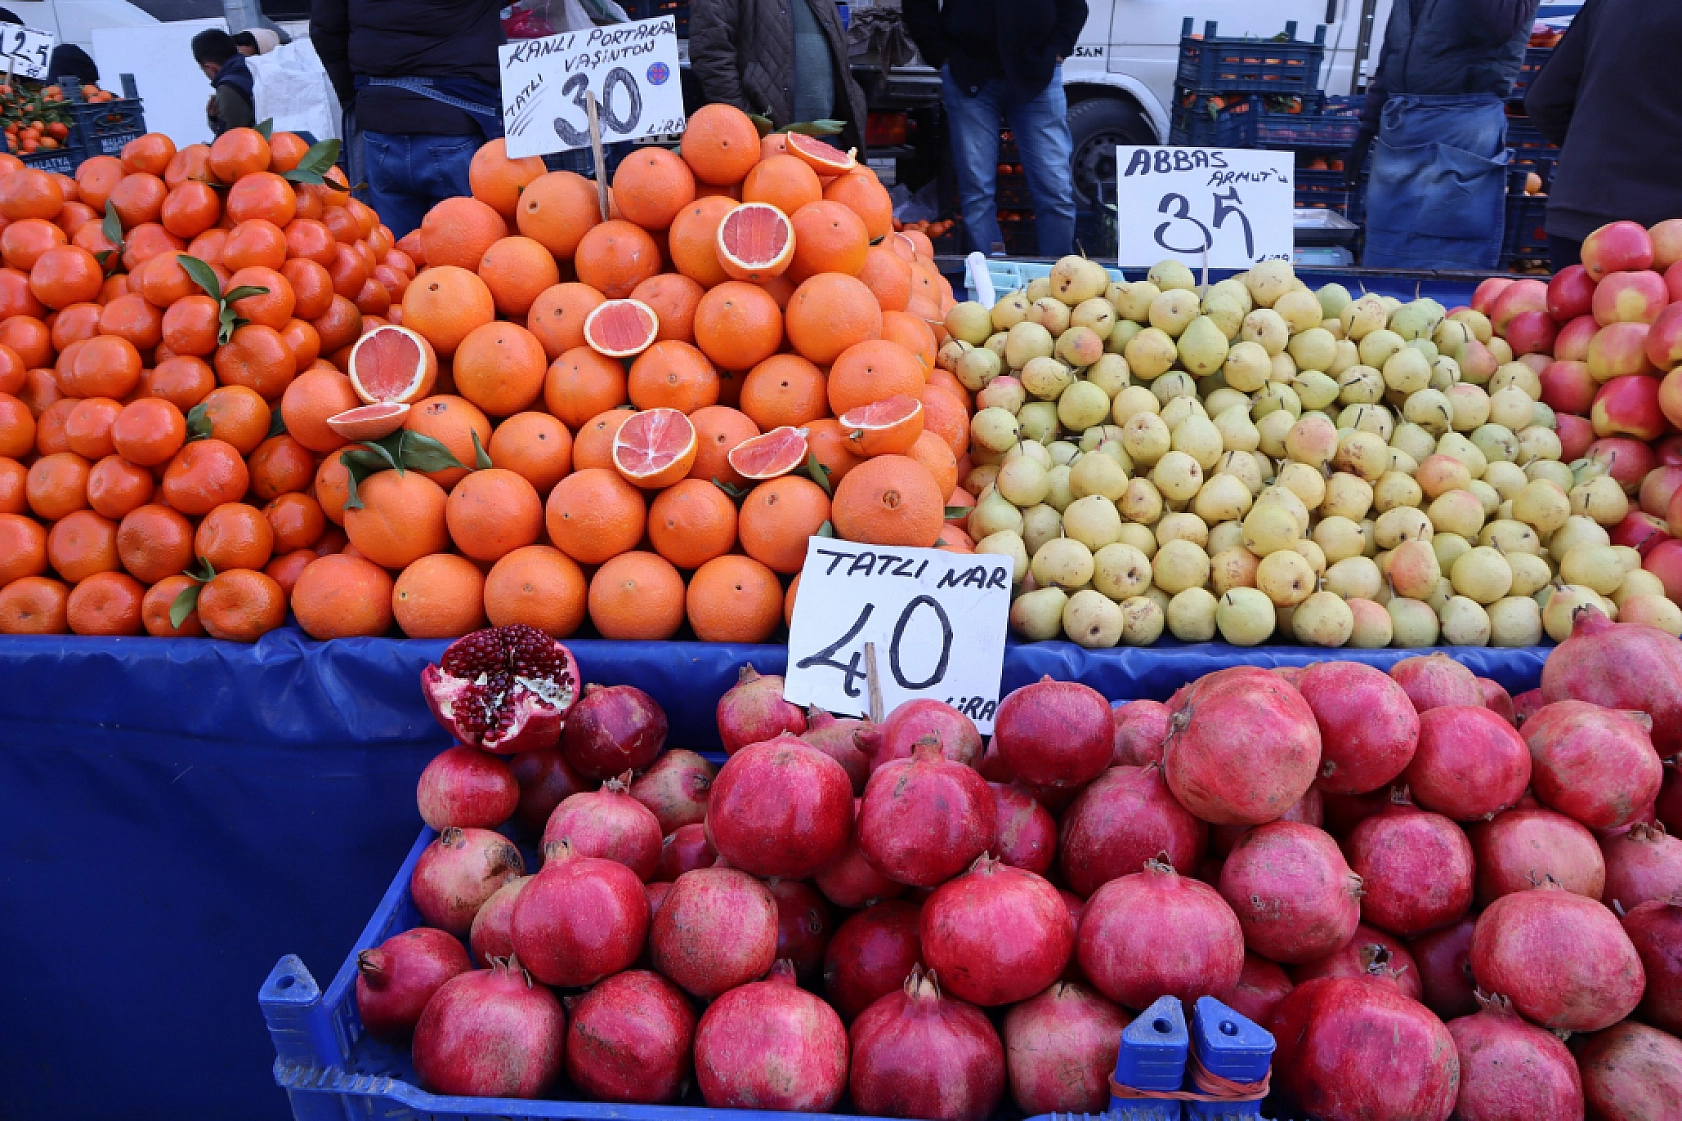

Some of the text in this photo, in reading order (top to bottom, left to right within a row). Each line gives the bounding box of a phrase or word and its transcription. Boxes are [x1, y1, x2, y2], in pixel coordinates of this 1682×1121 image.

[506, 33, 576, 69] KANLI
[1075, 46, 1103, 57] SAN
[504, 73, 544, 117] TATLI
[553, 66, 643, 147] 30
[1124, 148, 1229, 177] ABBAS
[1154, 186, 1254, 259] 35
[816, 548, 1007, 589] TATLI NAR
[796, 594, 953, 698] 40
